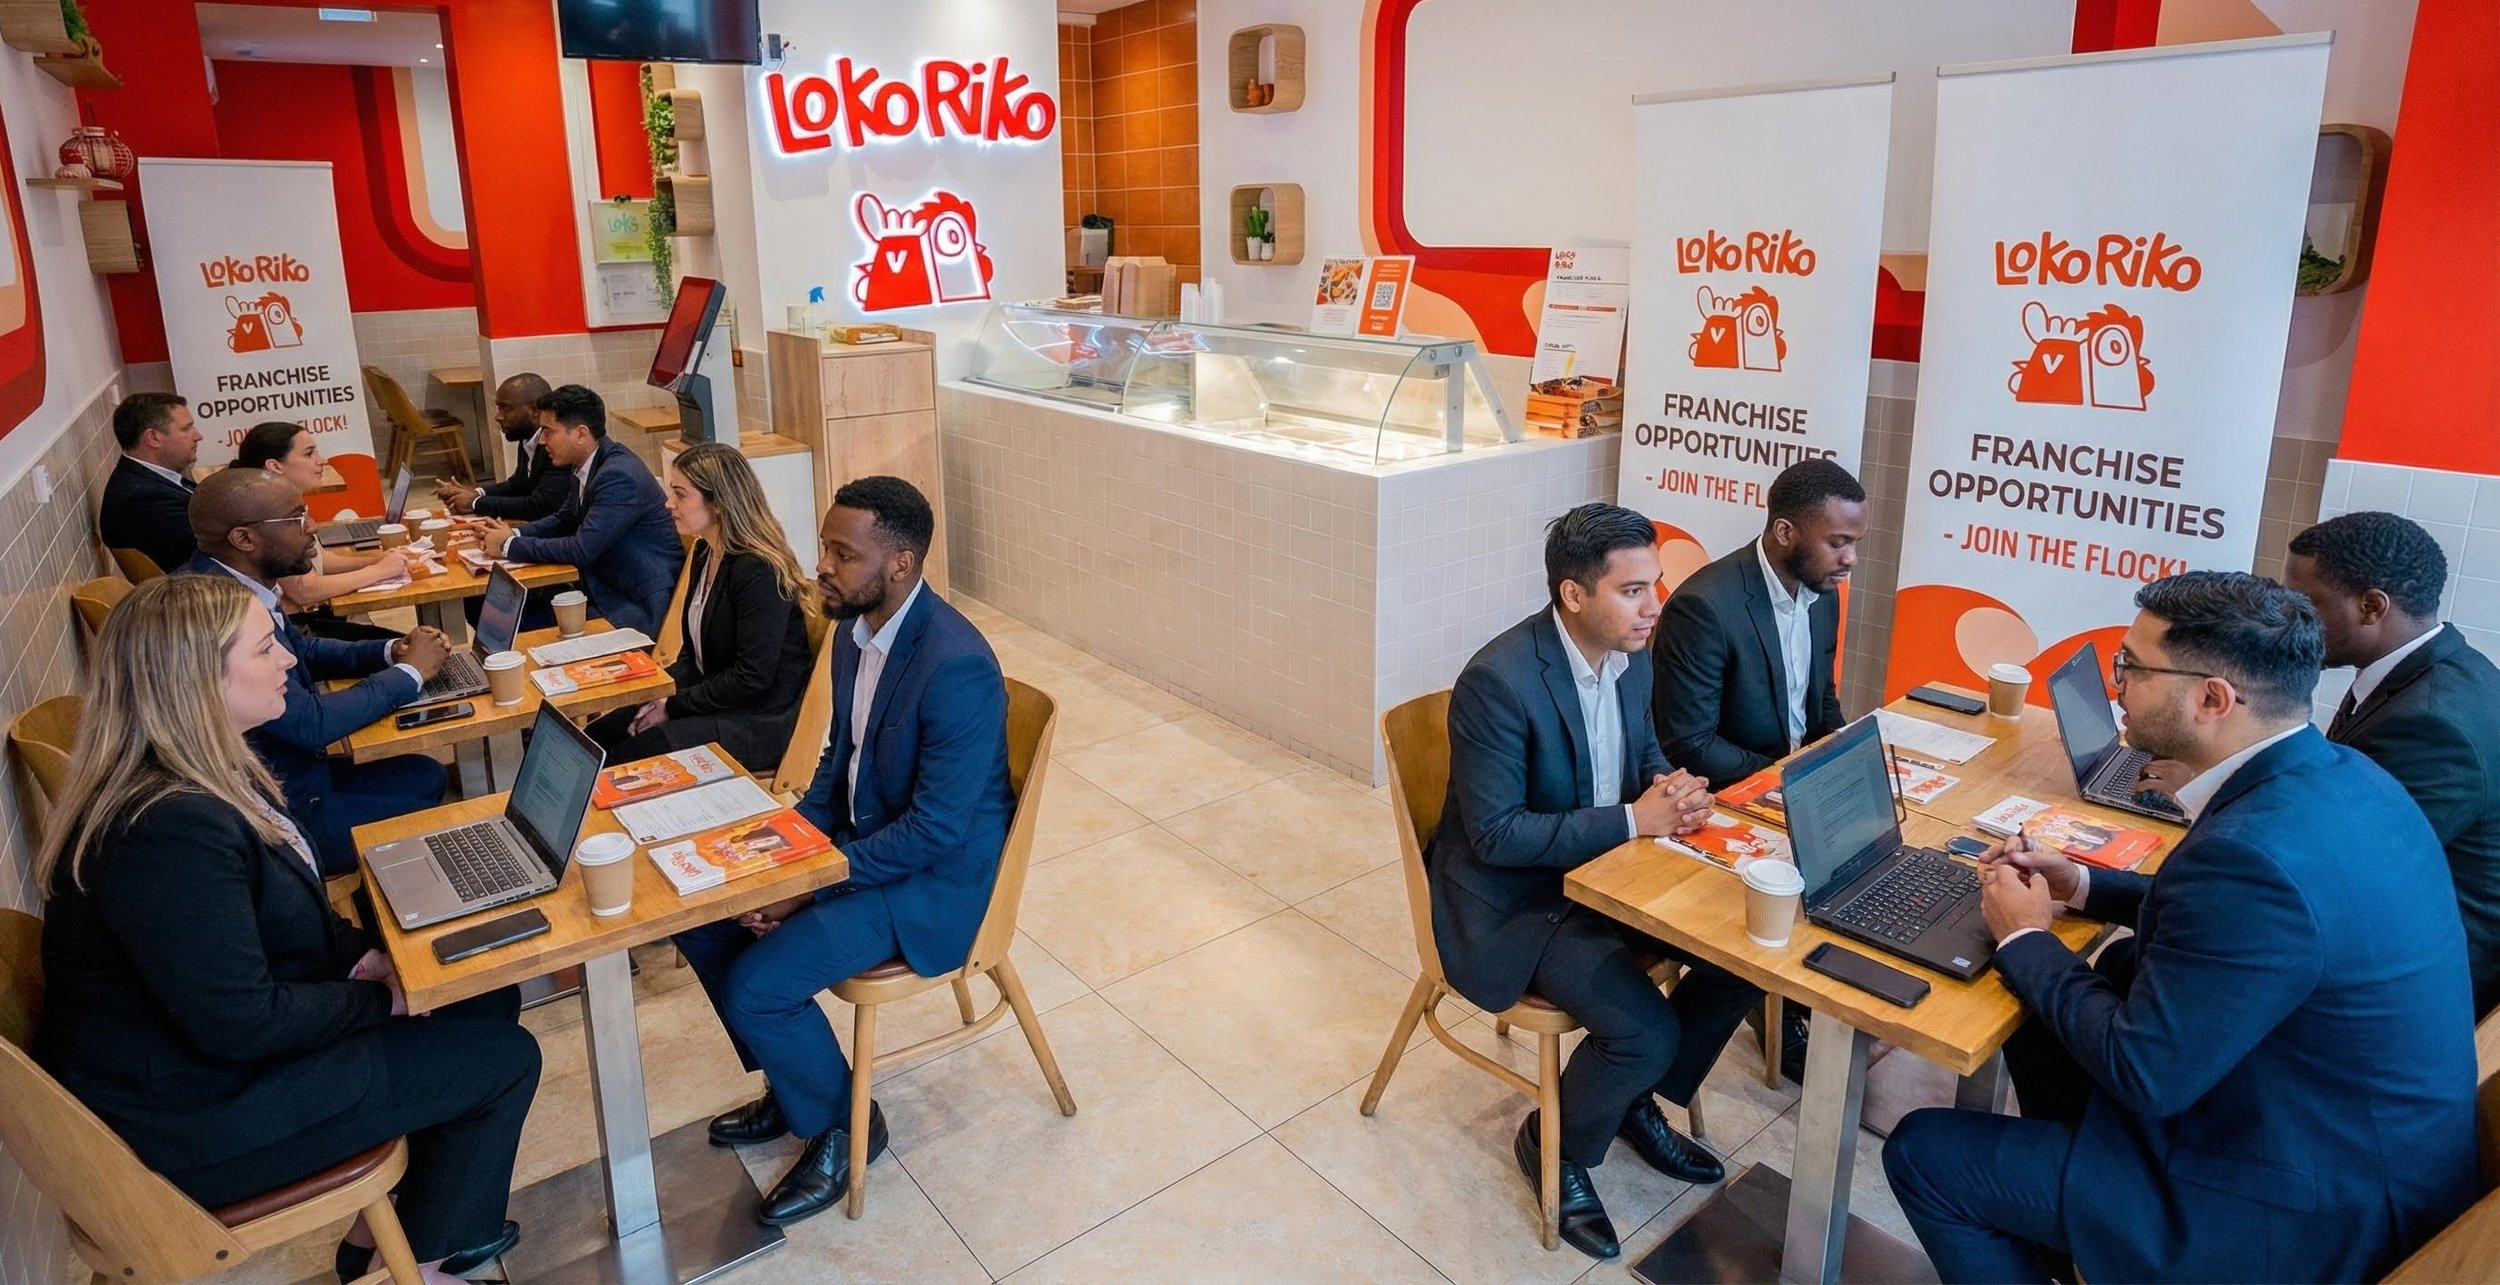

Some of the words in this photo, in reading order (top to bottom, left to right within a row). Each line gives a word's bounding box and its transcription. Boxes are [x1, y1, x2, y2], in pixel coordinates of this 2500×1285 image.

[217, 365, 331, 393] FRANCHISE
[197, 385, 355, 419] OPPORTUNITIES
[1664, 393, 1808, 435] FRANCHISE
[1971, 433, 2184, 489] FRANCHISE
[1658, 469, 1698, 496] JOIN
[1704, 475, 1739, 503] THE
[1929, 469, 2225, 540] OPPORTUNITIES
[1961, 525, 2018, 558] JOIN
[2027, 534, 2078, 569] THE
